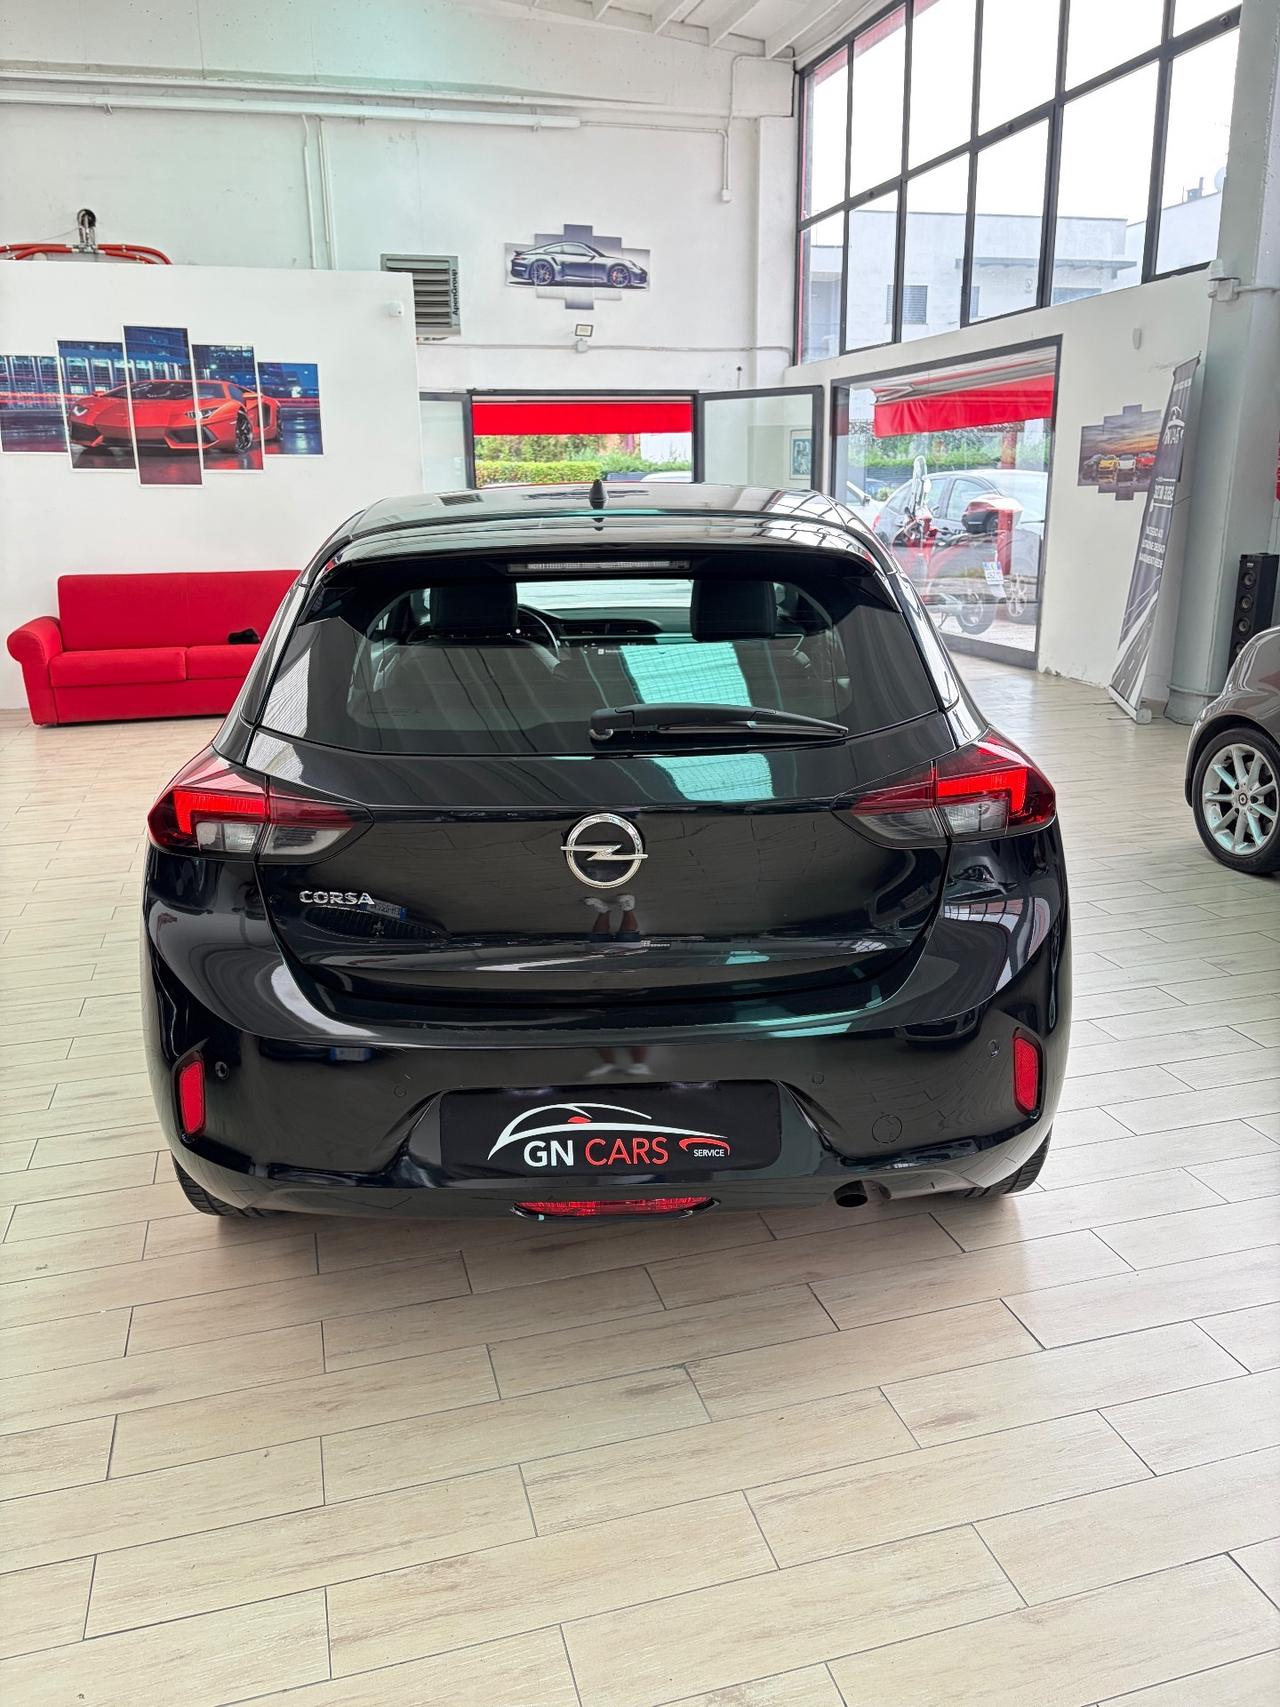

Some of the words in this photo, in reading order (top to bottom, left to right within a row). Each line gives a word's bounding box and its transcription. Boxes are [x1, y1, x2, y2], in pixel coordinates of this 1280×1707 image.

[451, 268, 459, 316] ApenGroup
[300, 890, 374, 905] CORSA
[523, 1139, 574, 1167] GN
[584, 1136, 669, 1166] CARS
[693, 1149, 725, 1157] SERVICE
